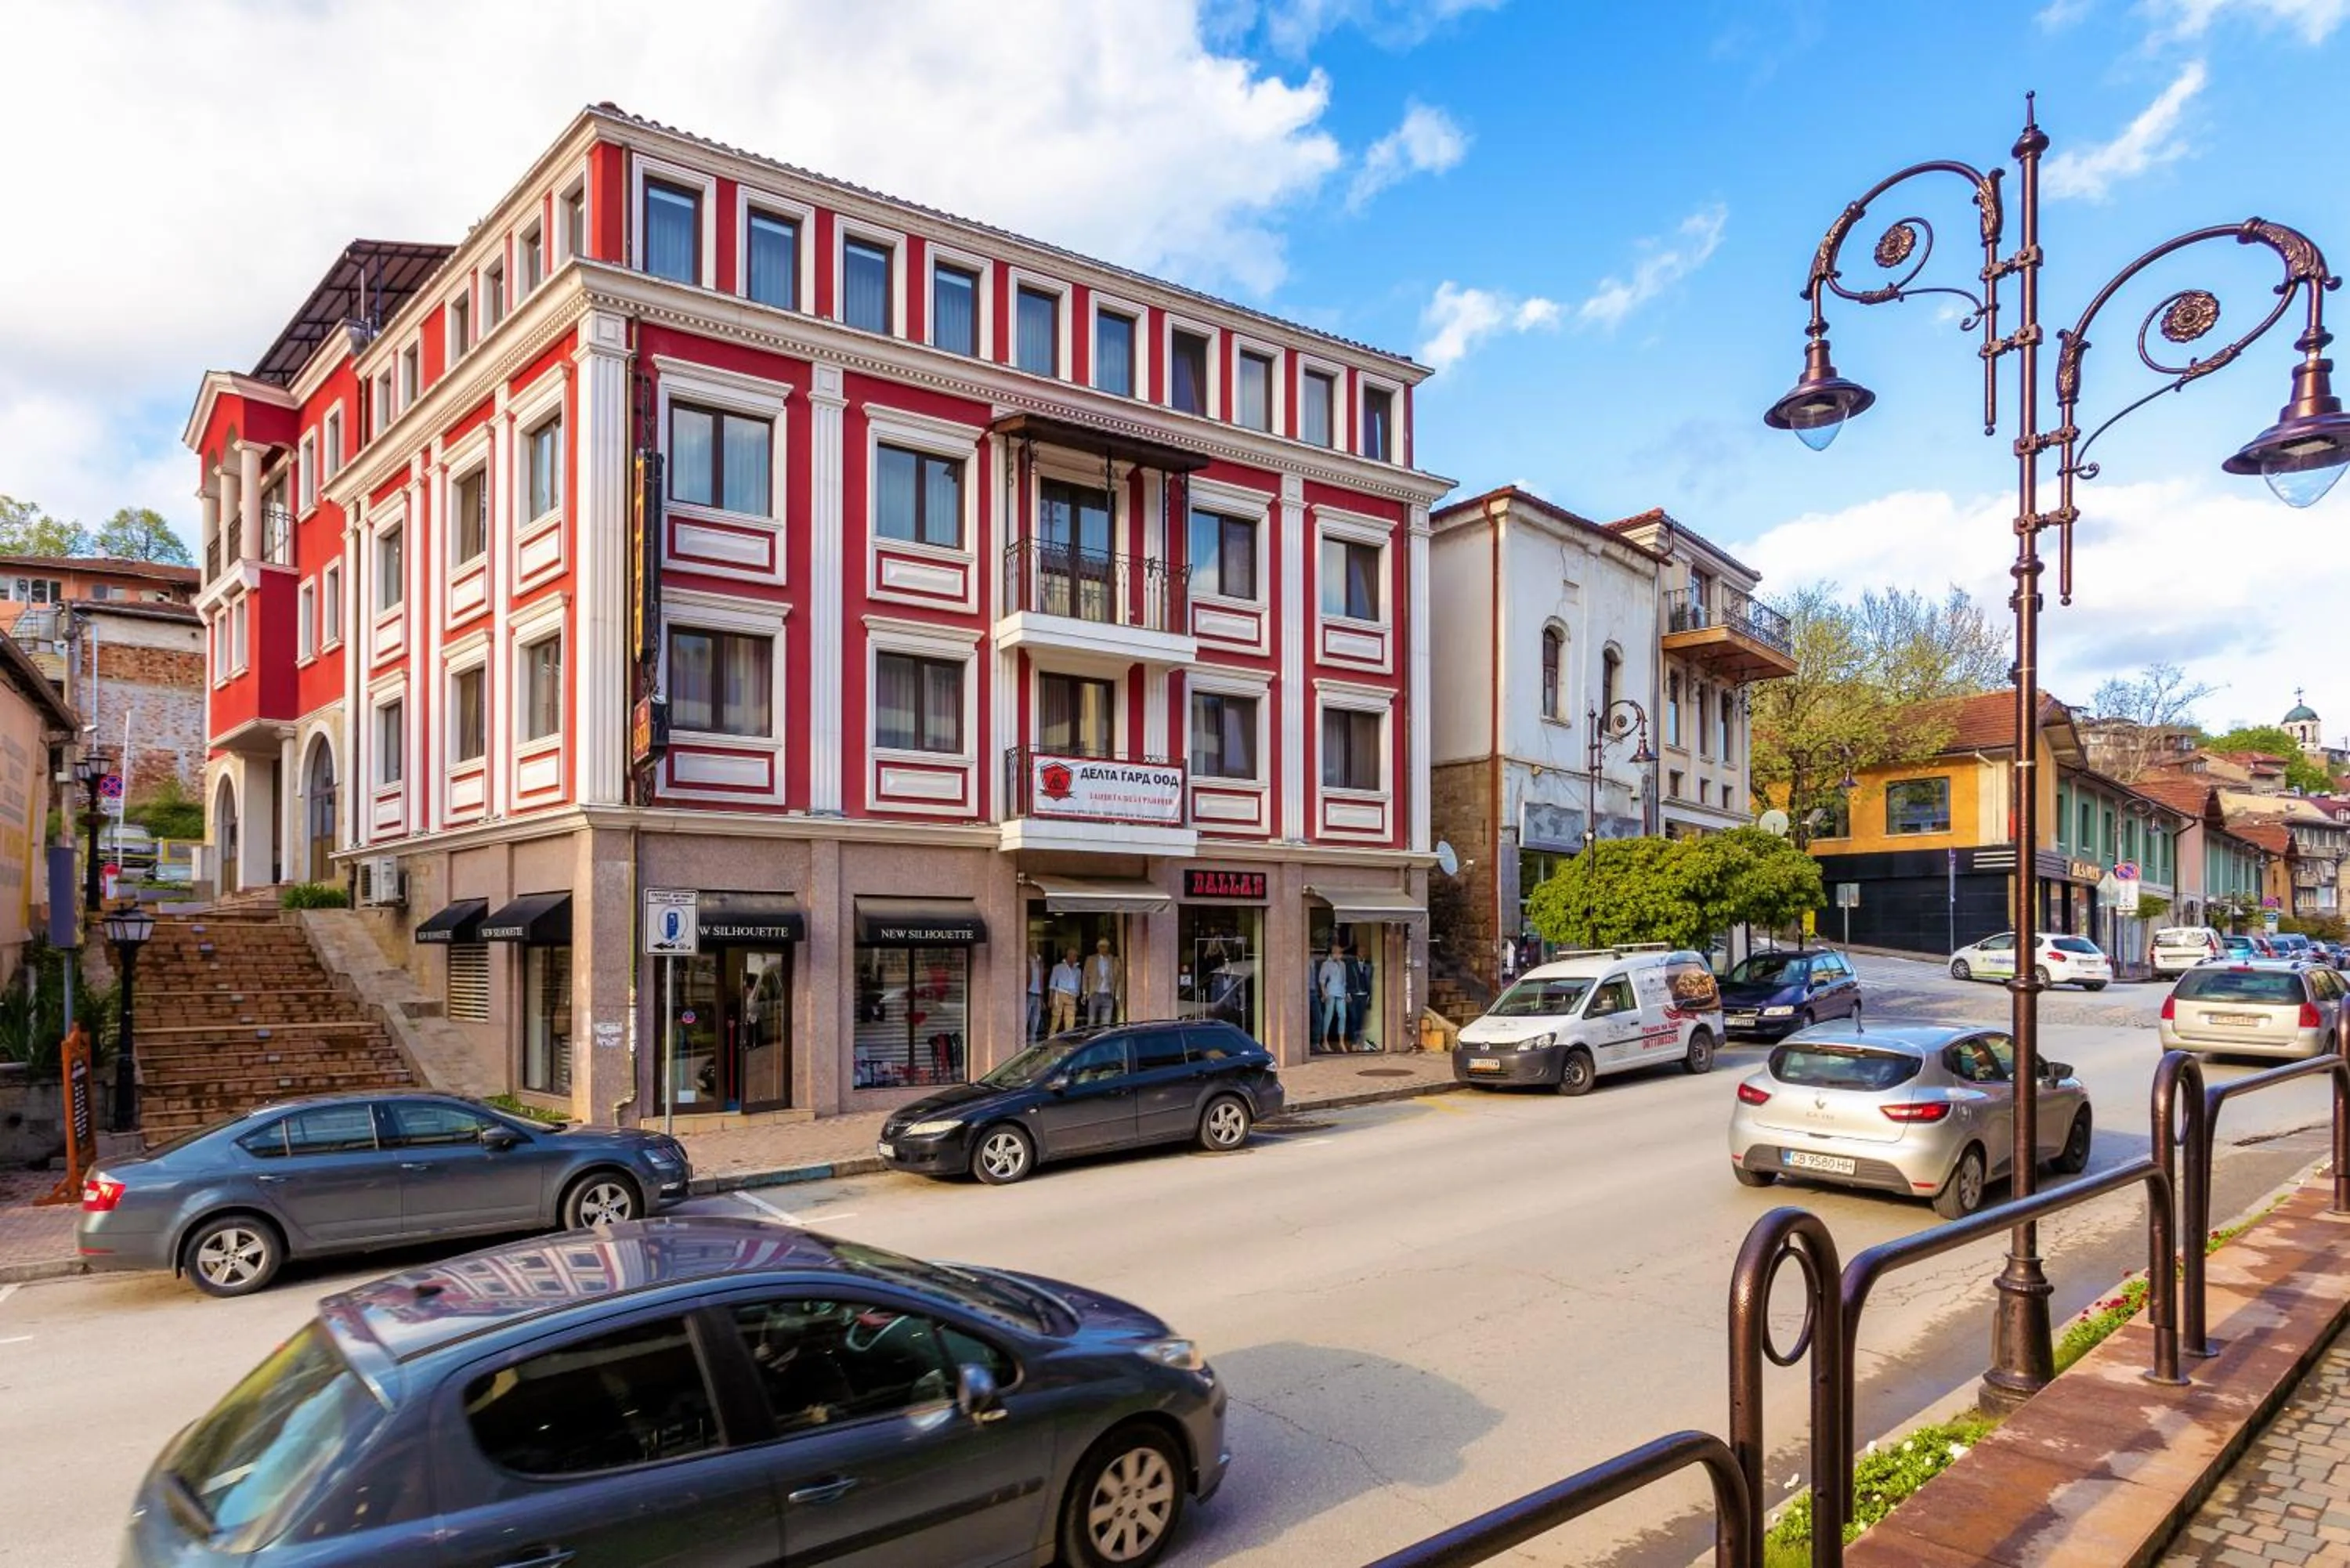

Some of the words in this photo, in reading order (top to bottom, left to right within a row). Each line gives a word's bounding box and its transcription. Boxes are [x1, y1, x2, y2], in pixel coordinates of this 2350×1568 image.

[1080, 768, 1118, 781] ДЕЛТА
[1121, 771, 1151, 785] ГАРД
[1153, 775, 1179, 788] ООД
[1193, 873, 1264, 895] DALLAS
[714, 927, 789, 938] SILHOUETTE
[881, 928, 907, 939] NEW
[908, 929, 974, 939] SILHOUETTE
[1808, 1155, 1835, 1169] 9580
[1837, 1160, 1852, 1171] HH
